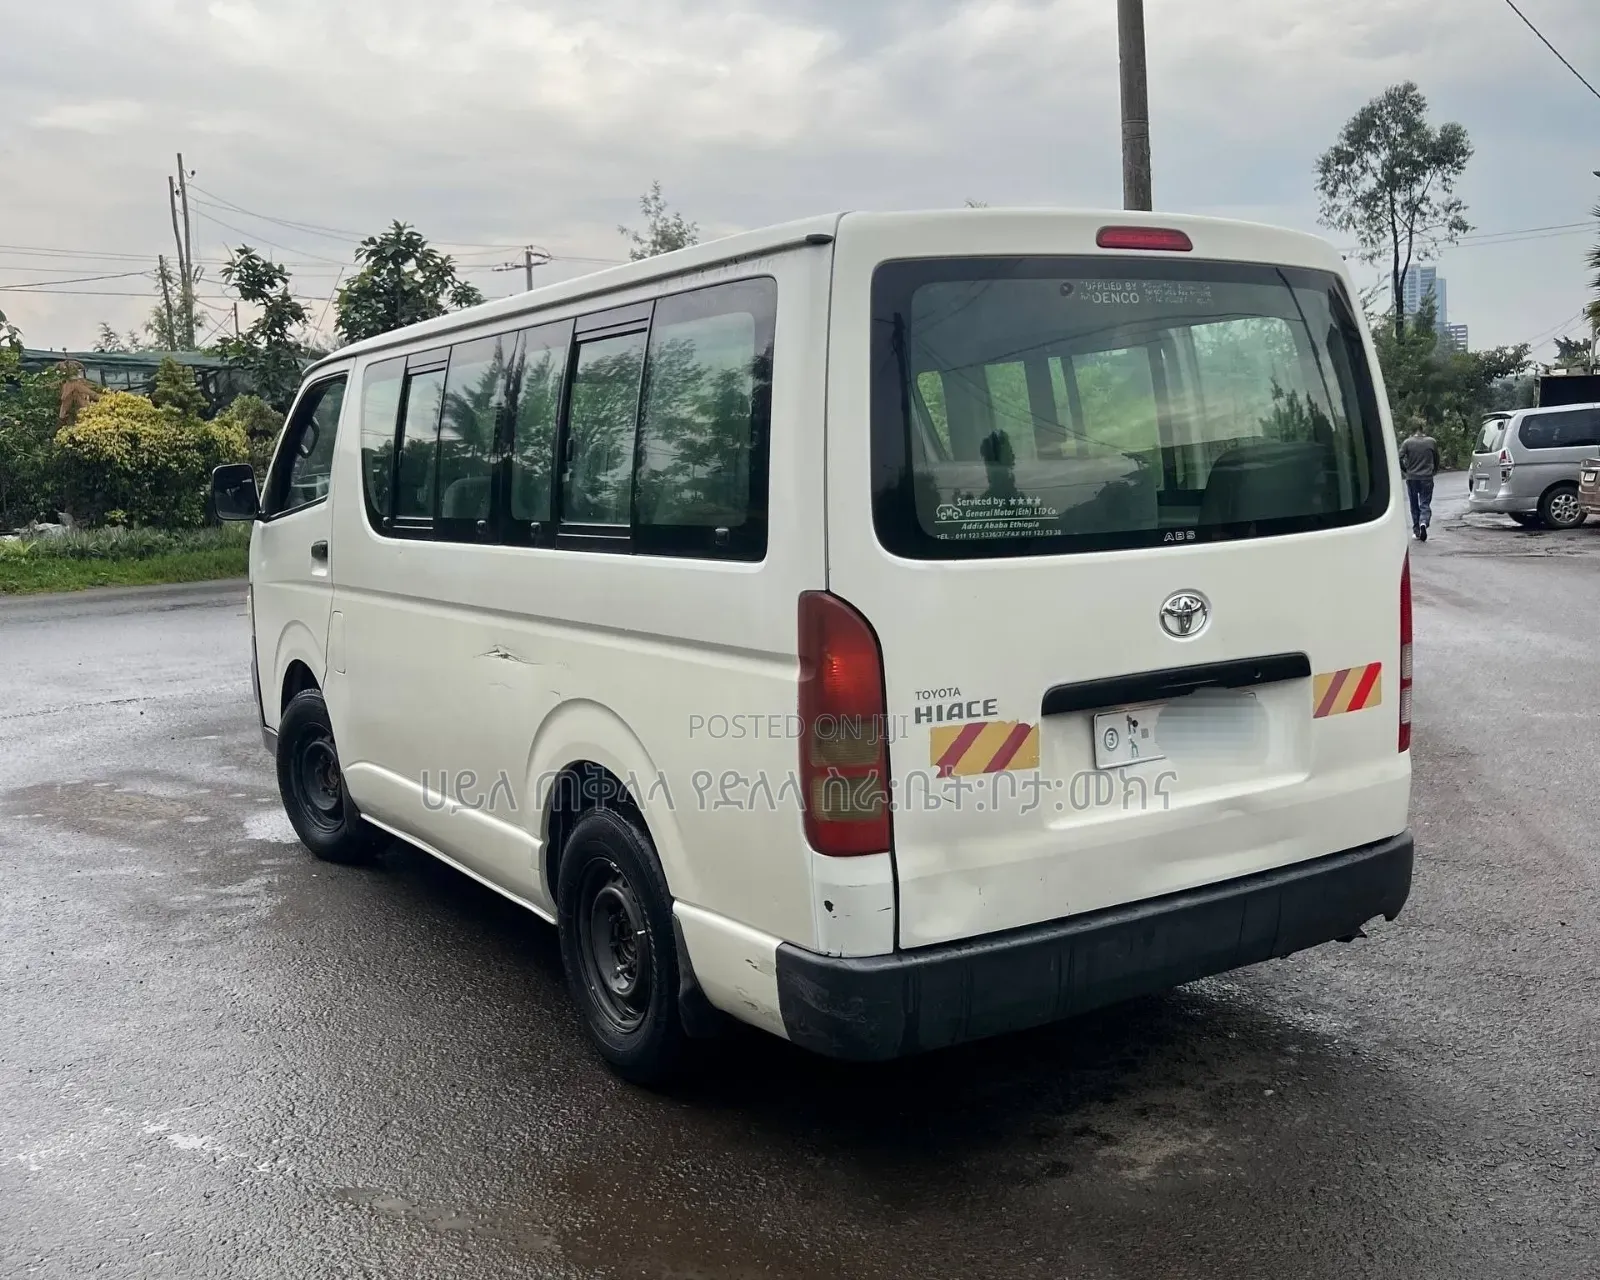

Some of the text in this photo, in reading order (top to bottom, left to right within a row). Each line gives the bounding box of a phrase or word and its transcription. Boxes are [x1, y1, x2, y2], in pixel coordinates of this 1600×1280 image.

[1125, 281, 1137, 291] BY
[957, 496, 1006, 507] Serviced by:
[940, 508, 959, 520] GMC
[966, 509, 992, 518] General
[993, 507, 1015, 517] Motor
[1015, 507, 1032, 516] (Eth)
[1034, 507, 1047, 515] LTD
[961, 521, 1040, 530] Addis Ababa Ethiopia
[1163, 530, 1196, 542] ABS
[915, 687, 962, 700] TOYOTA
[915, 698, 998, 724] HIACE
